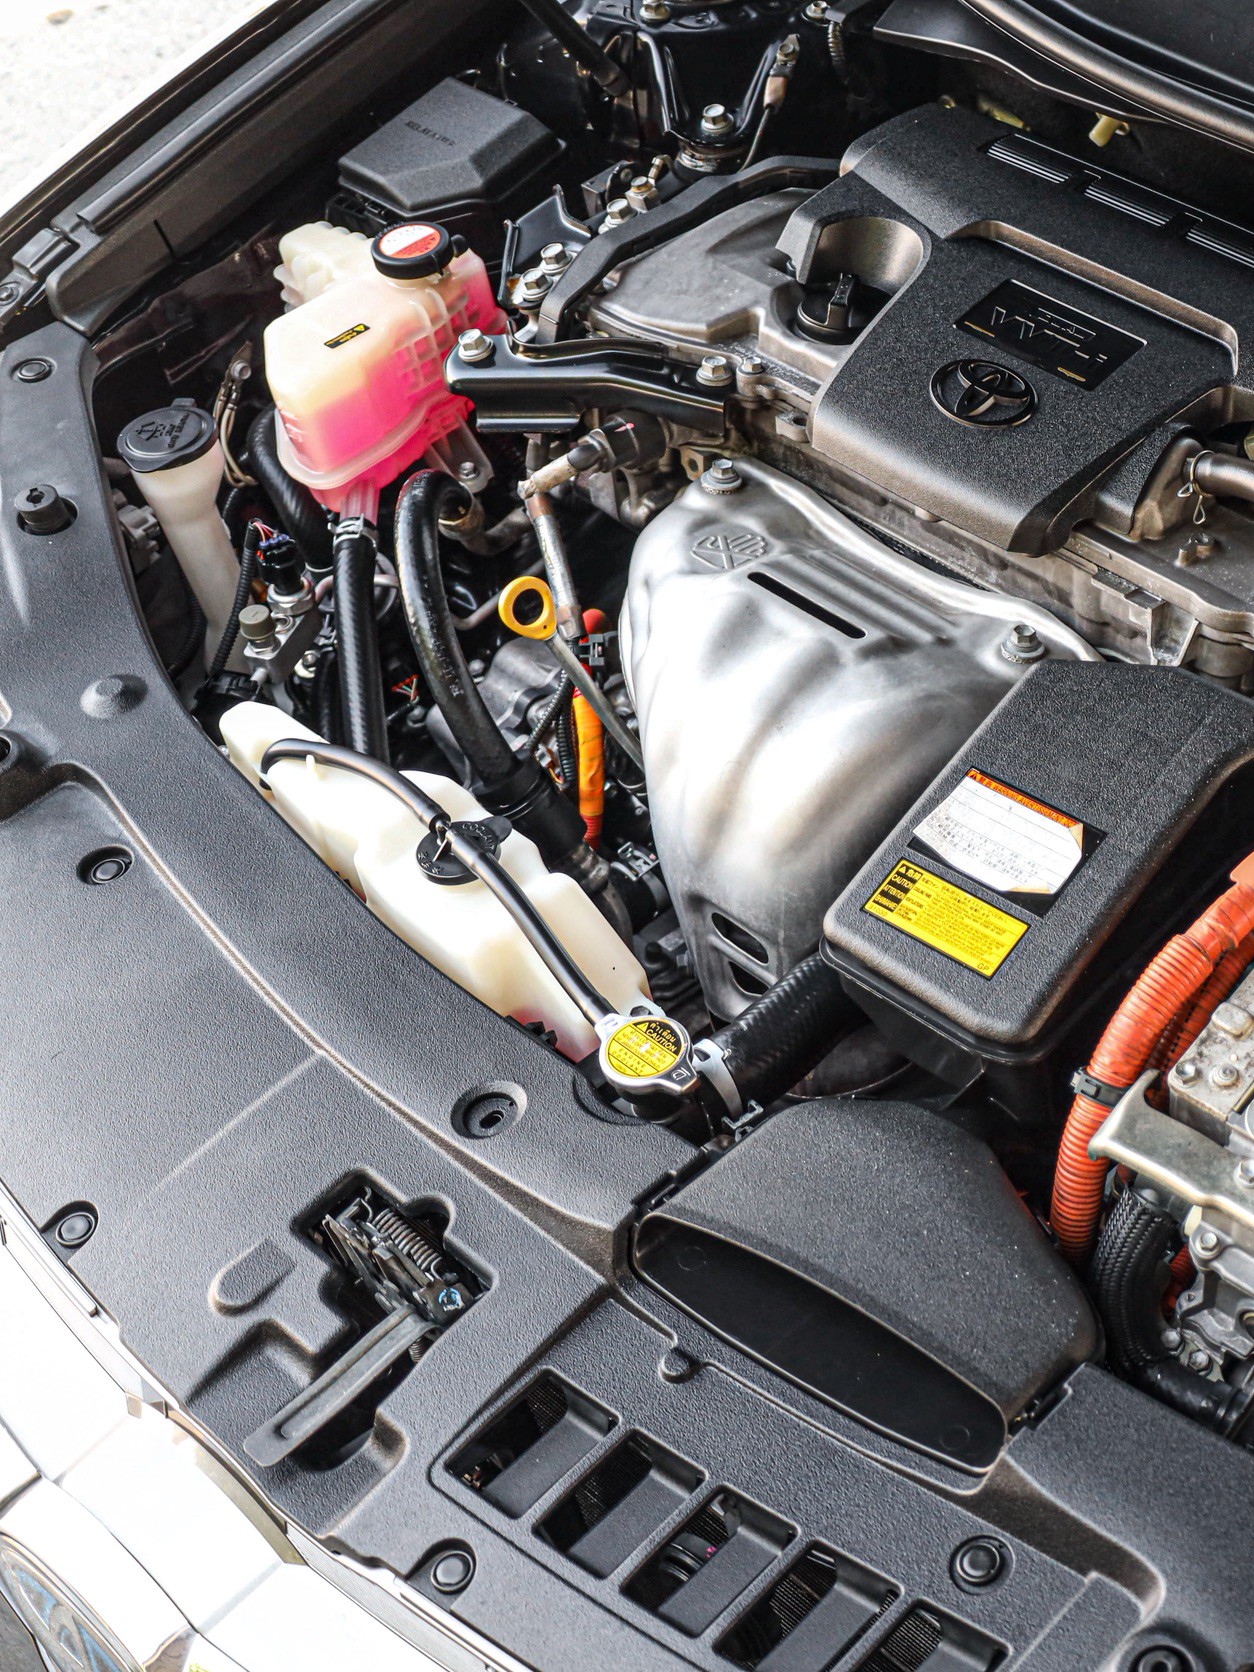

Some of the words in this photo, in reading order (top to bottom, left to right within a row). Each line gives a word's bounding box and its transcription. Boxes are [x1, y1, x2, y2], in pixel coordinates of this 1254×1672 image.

[992, 782, 1020, 801] WARNING
[889, 873, 914, 890] CAUTION
[882, 883, 906, 900] ATTENTION
[976, 961, 990, 973] GP
[645, 1027, 677, 1052] CAUTION
[618, 1047, 646, 1069] ENGINE
